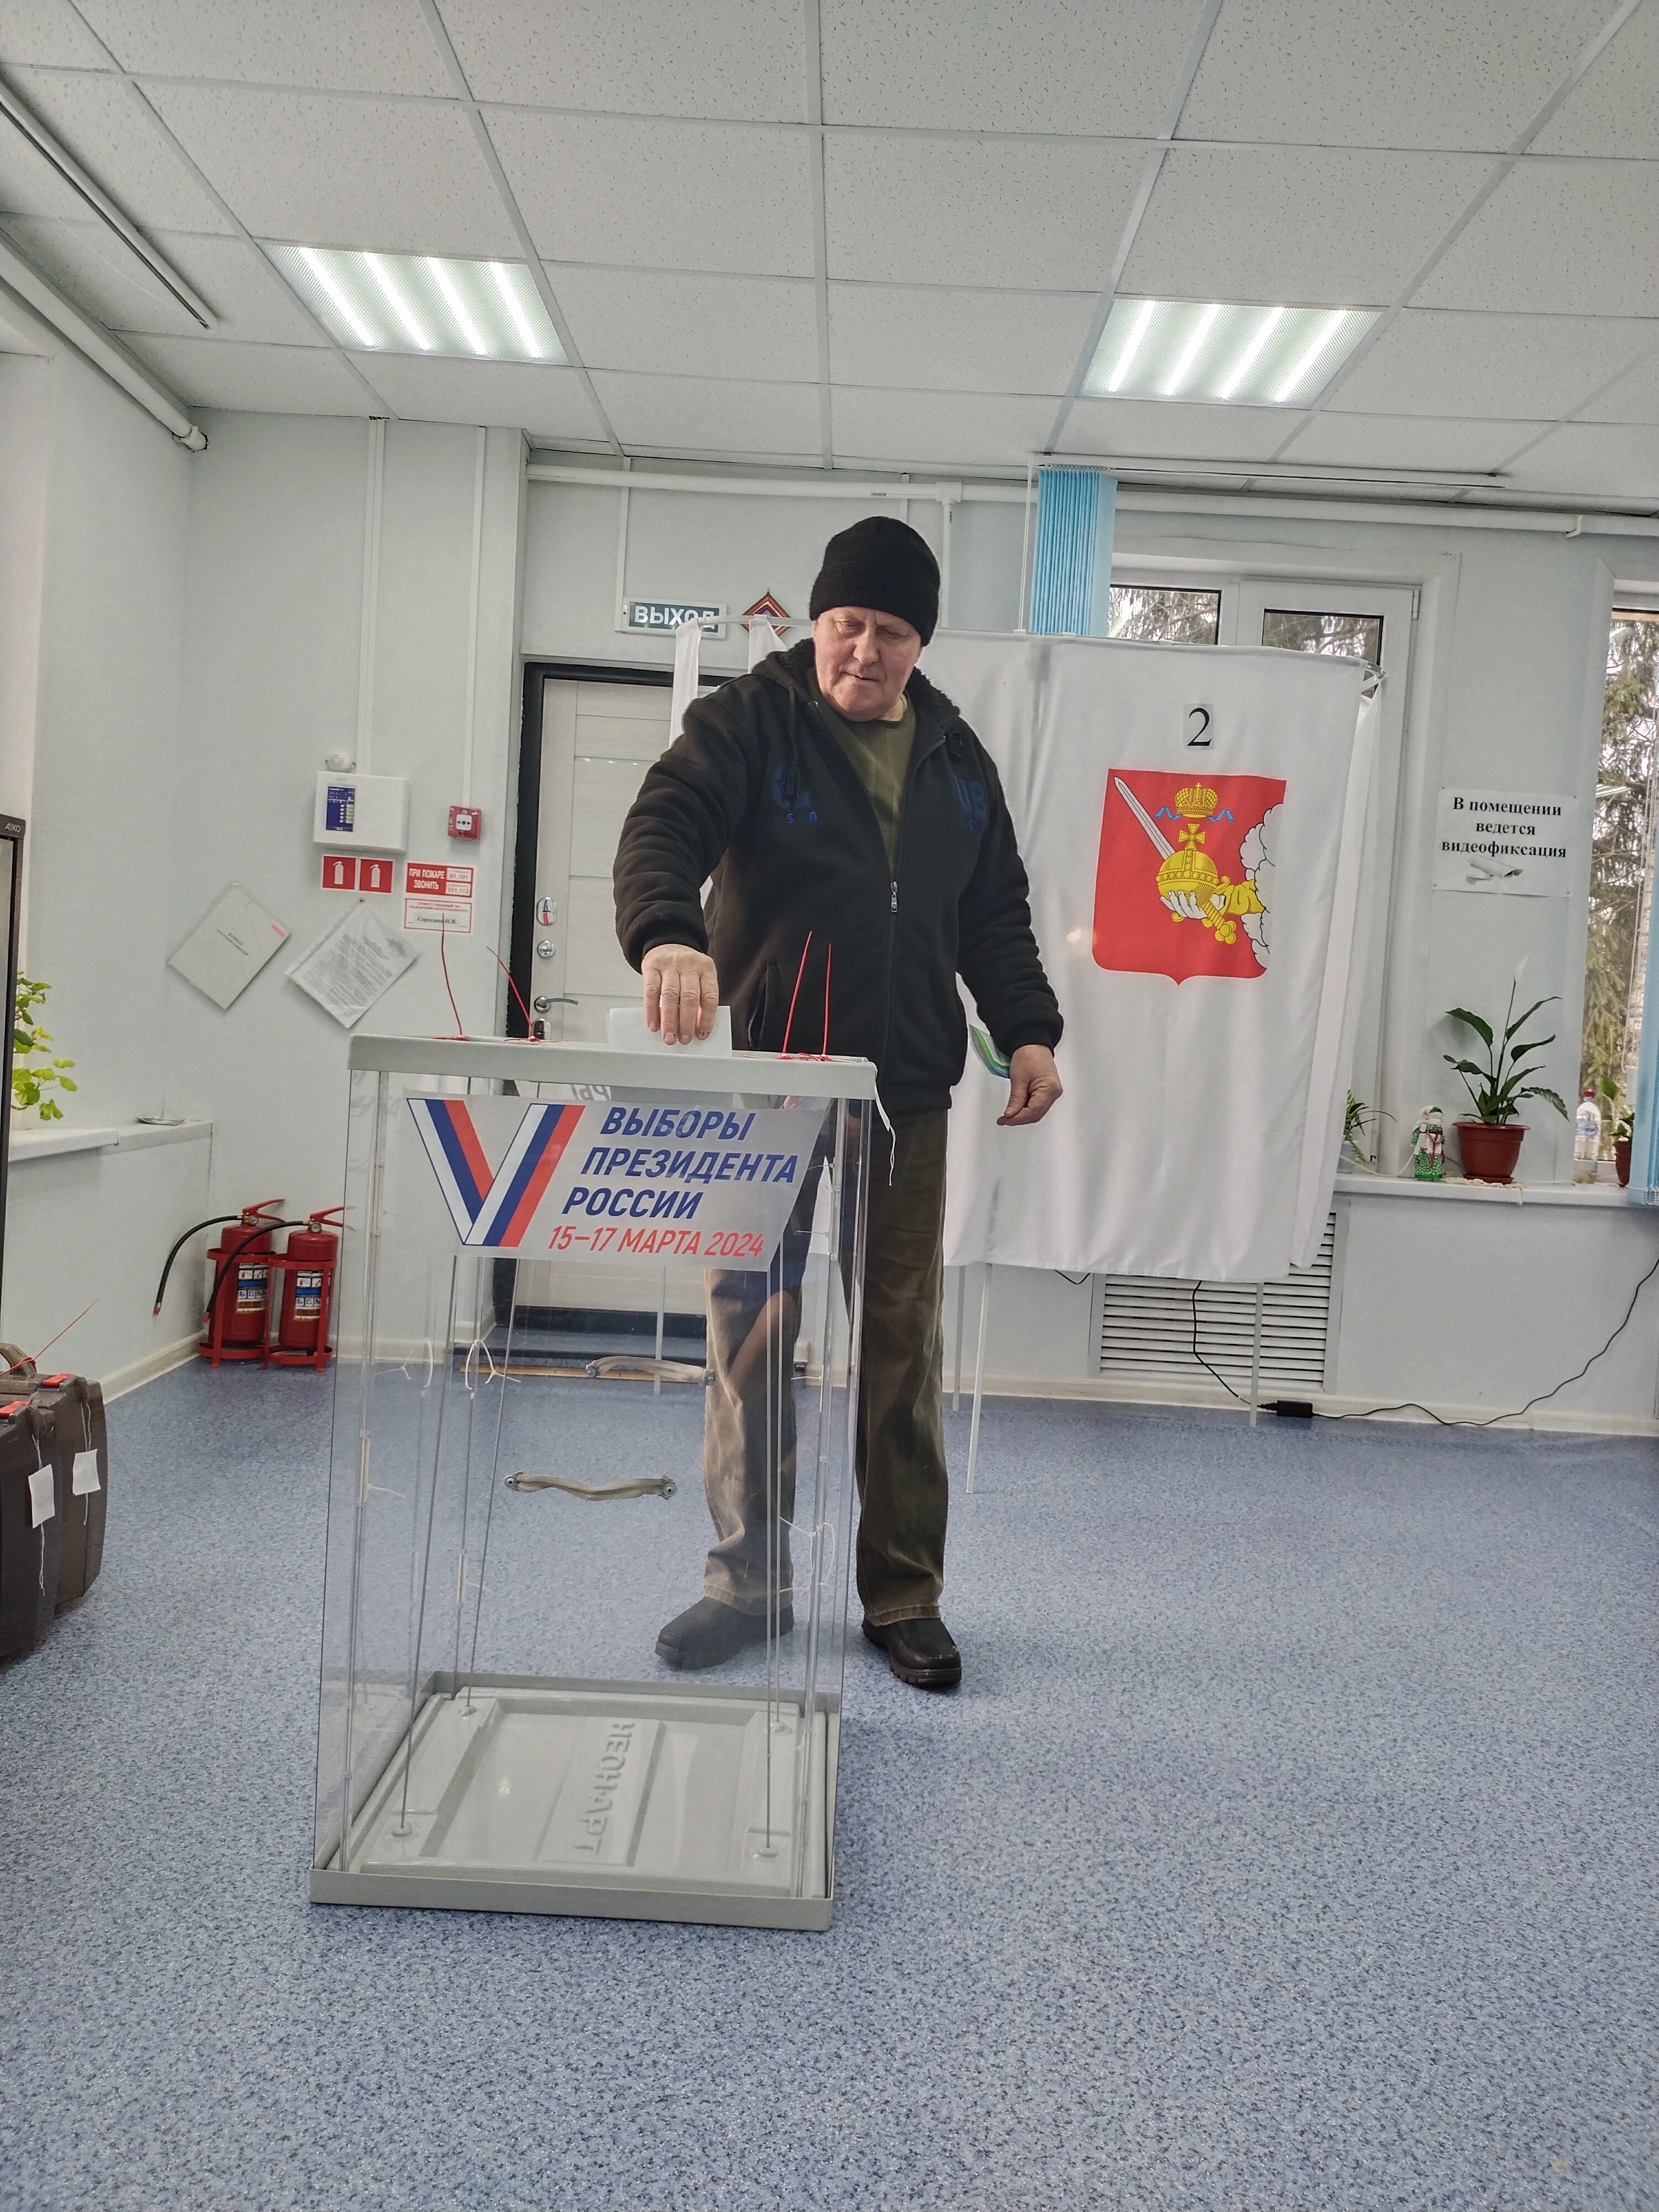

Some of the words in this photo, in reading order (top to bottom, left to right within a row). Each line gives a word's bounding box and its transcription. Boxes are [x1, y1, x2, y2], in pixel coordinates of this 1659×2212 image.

[1187, 707, 1212, 746] 2
[1453, 797, 1464, 810] В
[1469, 801, 1562, 816] помещении
[4, 822, 21, 833] AIKO
[1476, 823, 1536, 835] ведется
[1442, 841, 1567, 858] видеофиксация
[409, 868, 421, 877] ПРИ
[422, 869, 445, 879] ПОЖАРЕ
[414, 879, 439, 890] ЗВОНИТЬ
[599, 1107, 757, 1140] ВЫБОРЫ
[580, 1147, 799, 1184] ПРЕЗИДЕНТА
[561, 1187, 704, 1219] РОССИИ
[617, 1228, 702, 1255] МАРТА
[704, 1232, 764, 1257] 2024
